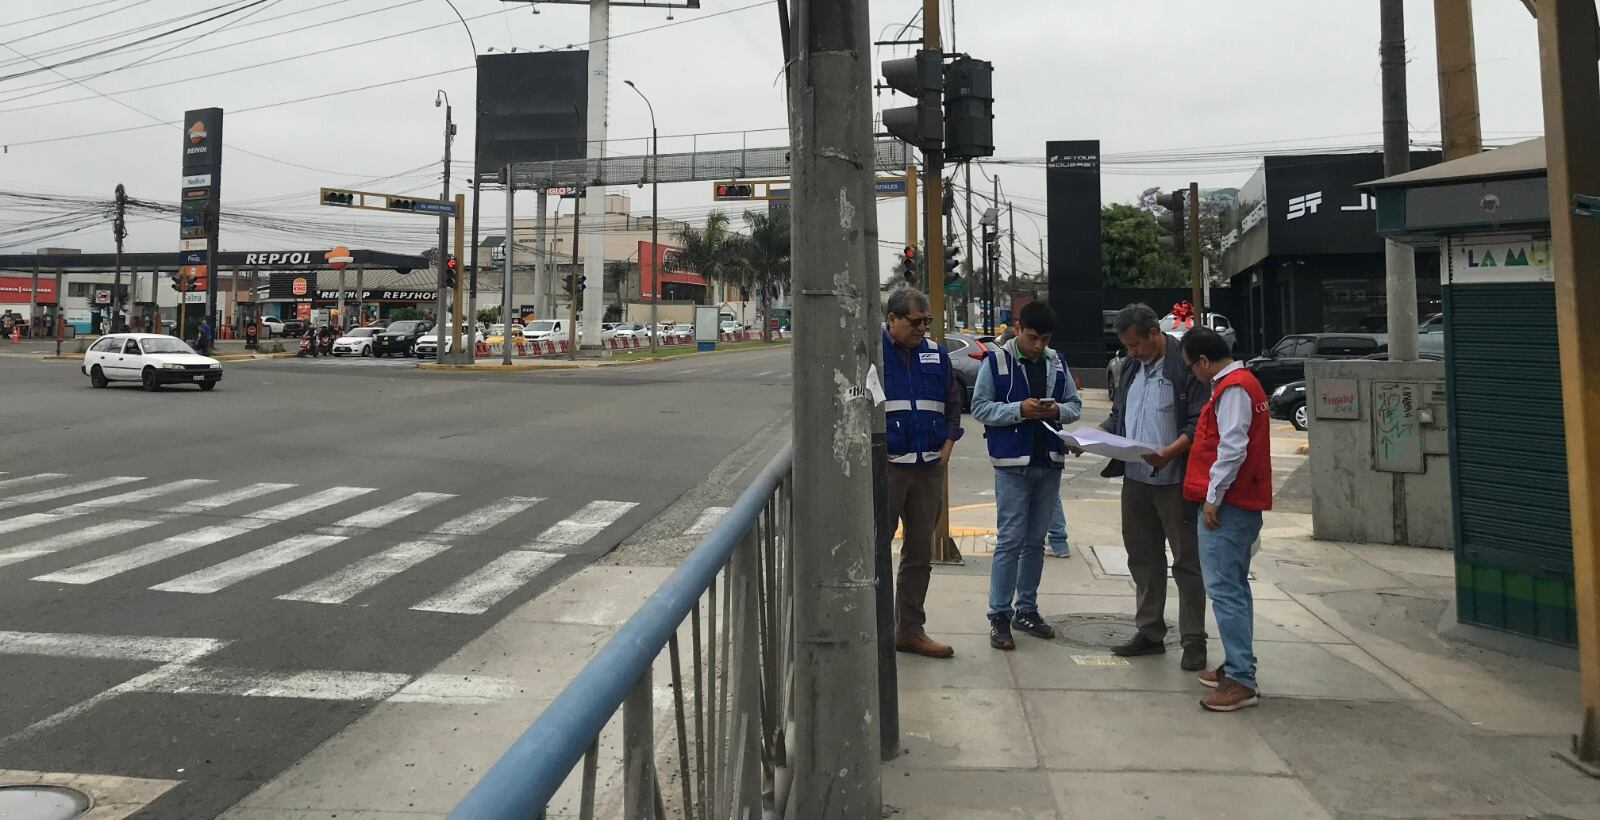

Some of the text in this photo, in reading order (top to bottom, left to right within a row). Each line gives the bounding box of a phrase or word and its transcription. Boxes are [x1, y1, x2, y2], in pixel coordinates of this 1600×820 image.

[245, 252, 311, 265] REPSOL
[1468, 248, 1497, 268] LA
[383, 291, 438, 300] REPSHOP
